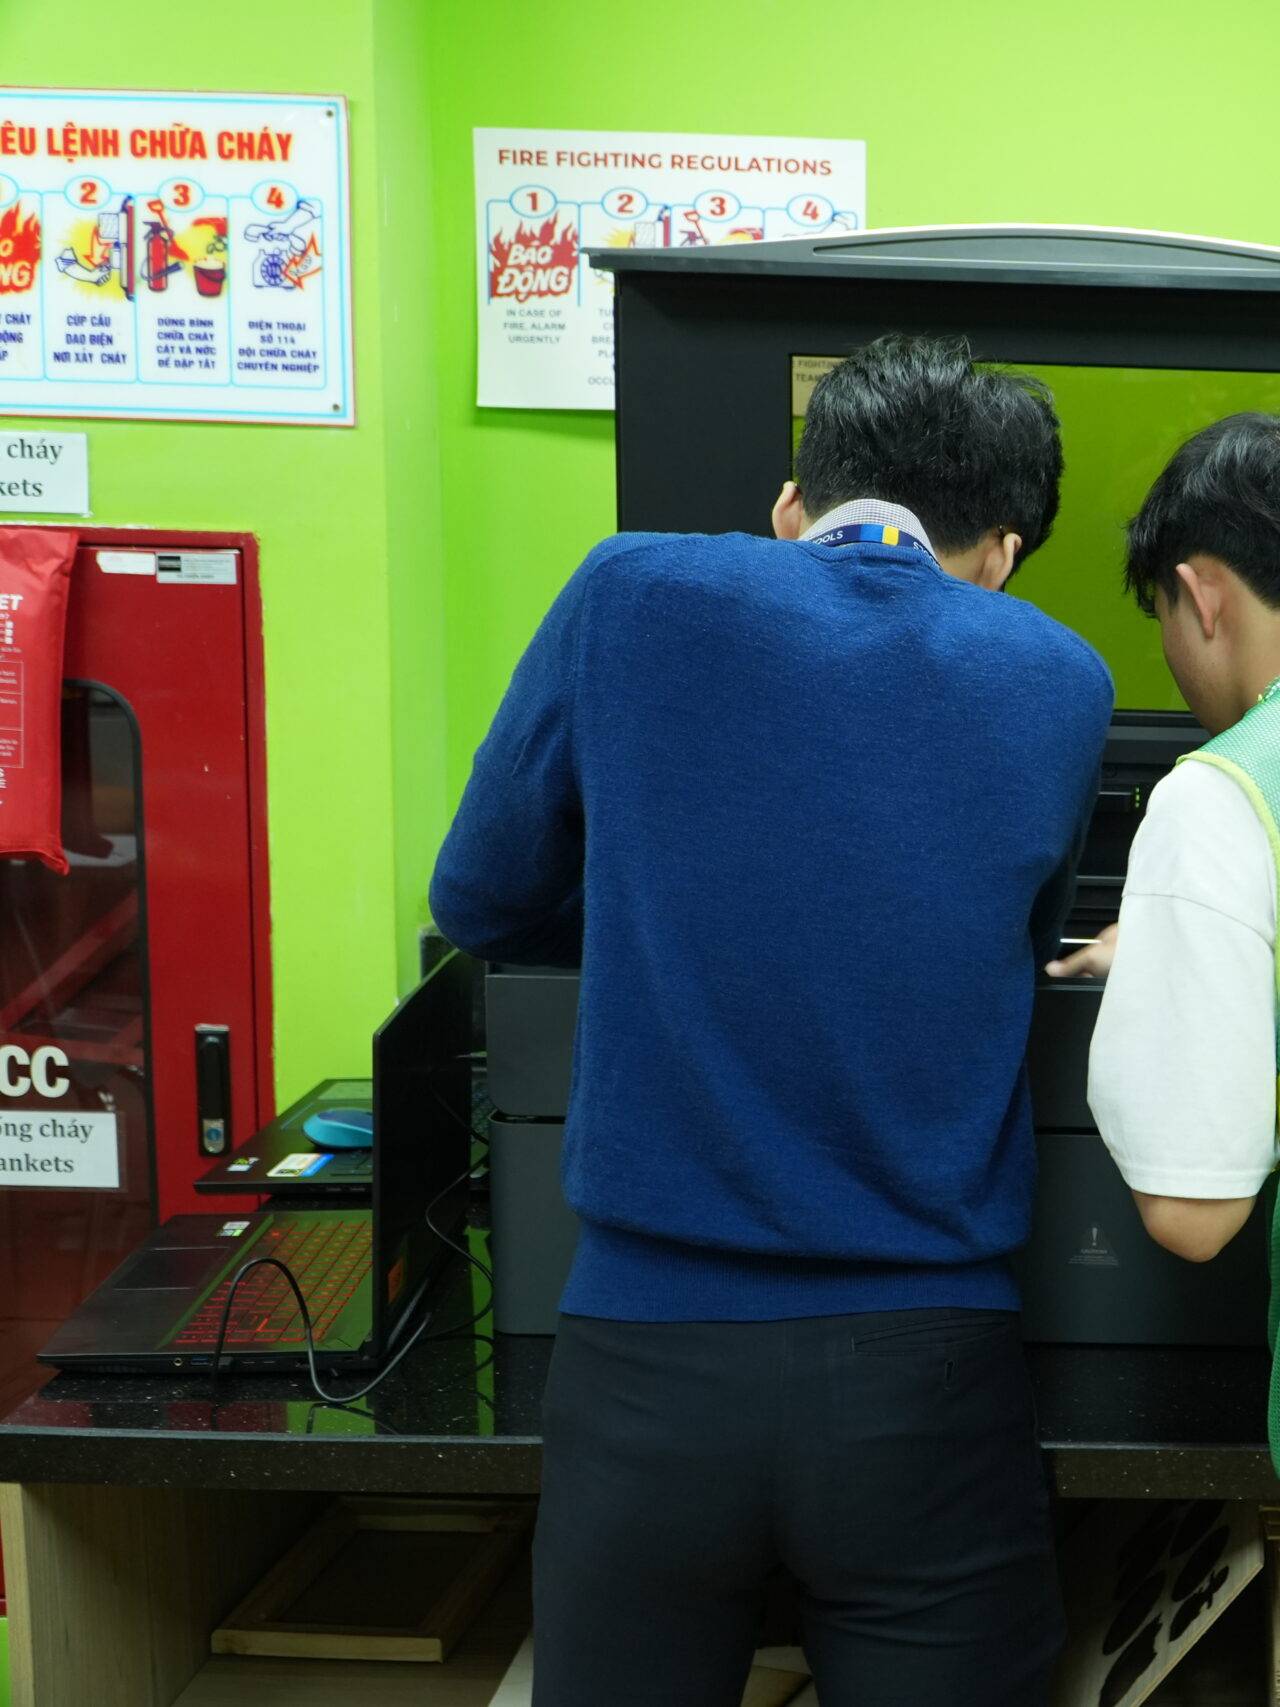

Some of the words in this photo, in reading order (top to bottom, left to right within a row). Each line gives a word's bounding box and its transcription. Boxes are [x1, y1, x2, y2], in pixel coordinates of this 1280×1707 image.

[46, 122, 119, 162] LỆNH
[130, 123, 207, 159] CHỮA
[217, 127, 292, 161] CHÁY
[498, 149, 548, 166] FIRE
[556, 150, 662, 169] FIGHTING
[670, 154, 833, 176] REGULATIONS
[80, 182, 97, 204] 2
[173, 184, 190, 206] 3
[267, 187, 284, 209] 4
[527, 192, 538, 211] 1
[617, 194, 634, 213] 2
[710, 197, 726, 217] 3
[802, 201, 819, 220] 4
[506, 241, 553, 266] BÁO
[496, 266, 569, 301] ĐỘNG
[519, 309, 545, 318] CASE
[599, 308, 614, 317] TU
[530, 322, 566, 331] ALARM
[508, 336, 561, 344] URGENTLY
[7, 438, 63, 465] cháy
[39, 1118, 94, 1144] cháy
